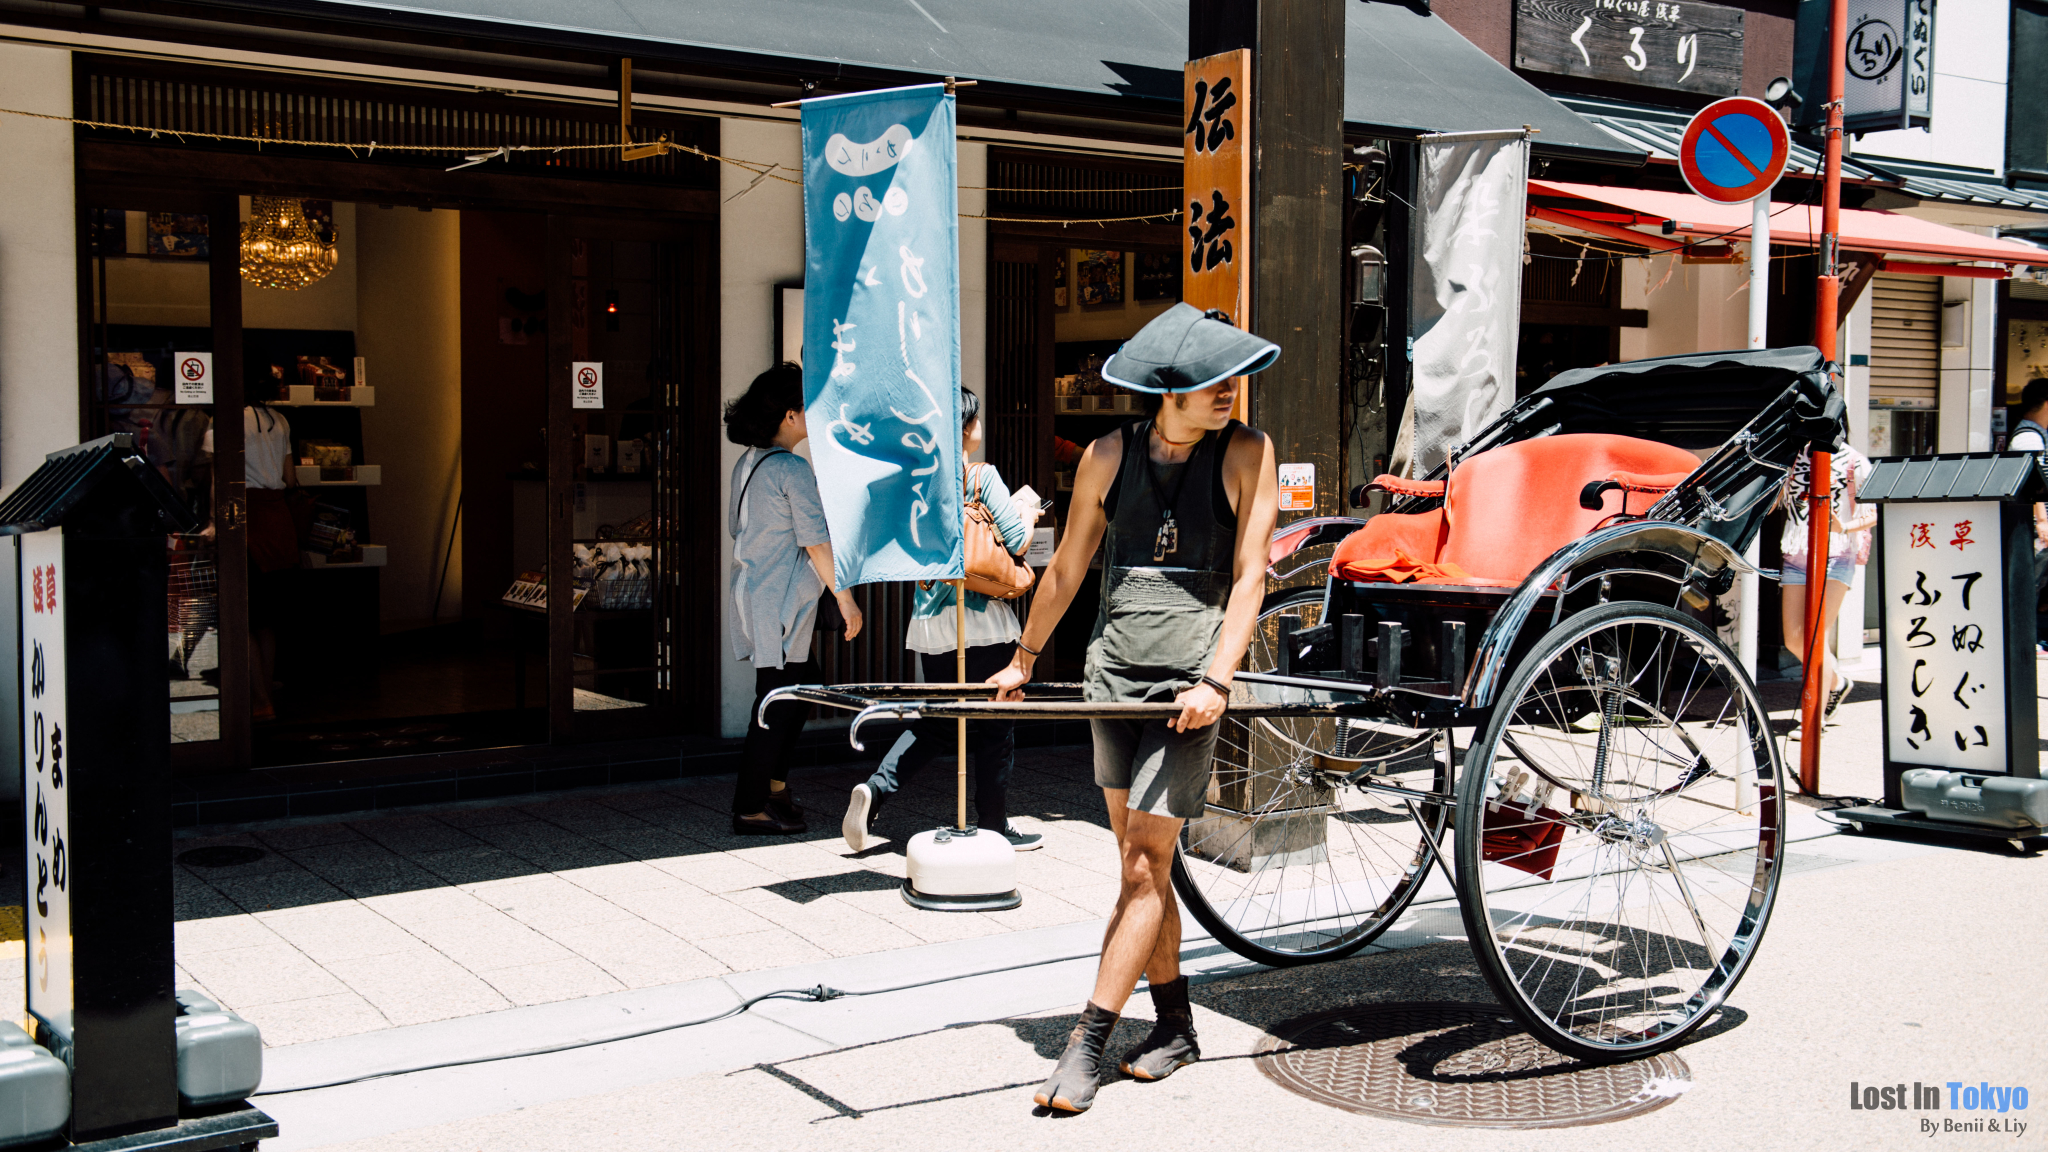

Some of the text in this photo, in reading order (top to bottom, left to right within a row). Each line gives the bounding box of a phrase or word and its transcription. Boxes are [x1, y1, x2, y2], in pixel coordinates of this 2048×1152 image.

[1570, 16, 1697, 84] くるり
[1655, 2, 1681, 22] 浅草
[1184, 76, 1236, 273] 伝法
[31, 563, 57, 615] 浅草
[1909, 520, 1975, 551] 浅草
[1901, 570, 1942, 750] ふろしき
[1950, 571, 1989, 752] てぬぐい
[31, 638, 48, 994] かりんとう
[50, 722, 66, 893] まめ
